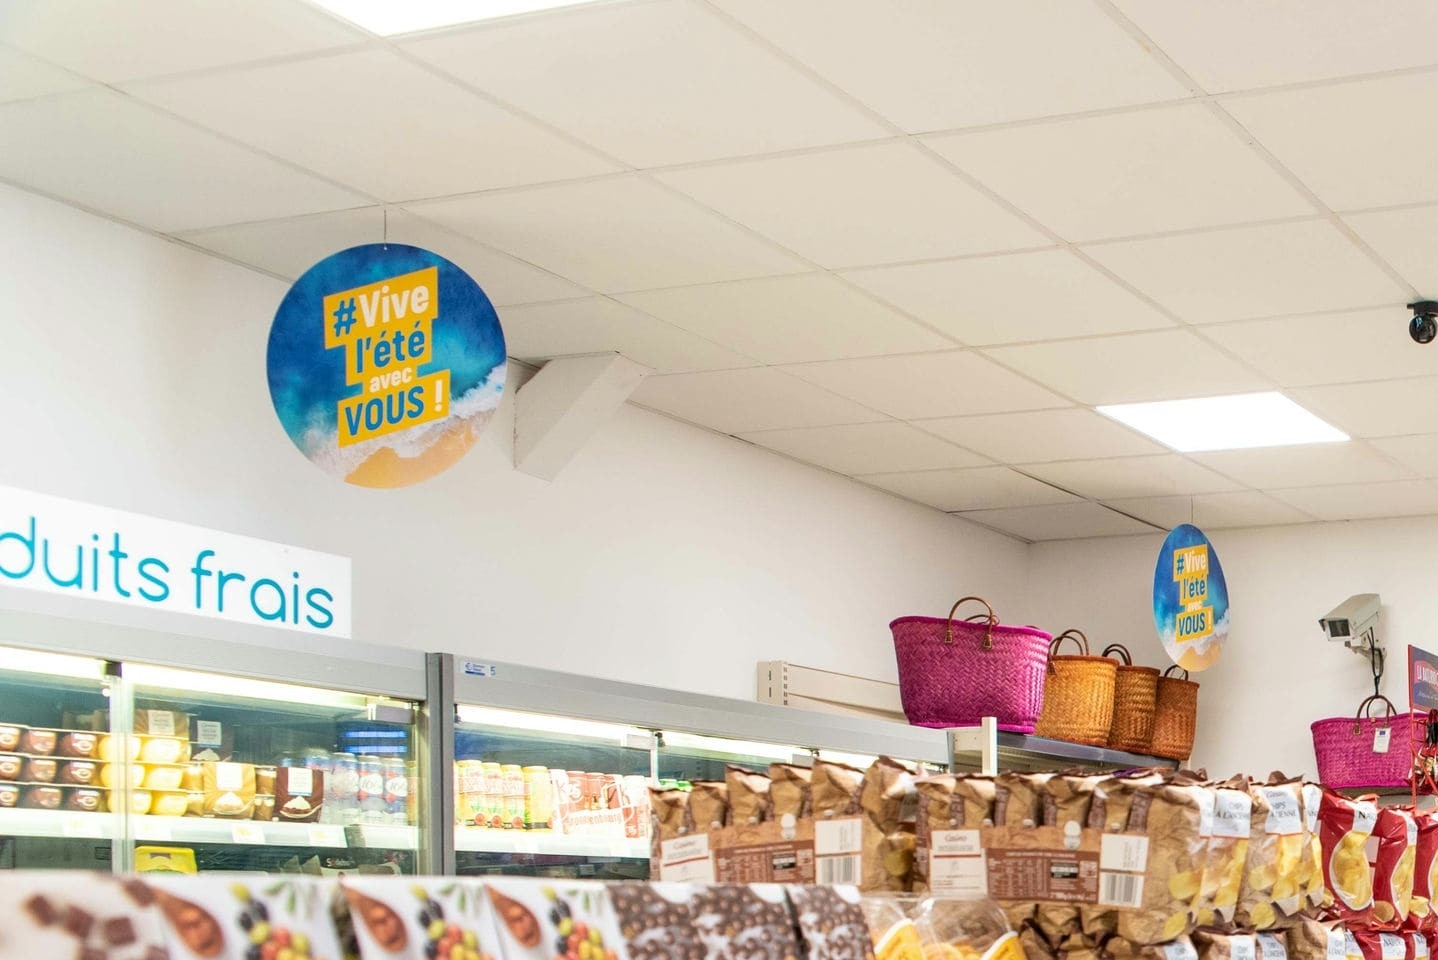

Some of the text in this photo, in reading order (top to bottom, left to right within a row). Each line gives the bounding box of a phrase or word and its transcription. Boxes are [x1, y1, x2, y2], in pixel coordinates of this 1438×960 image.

[334, 282, 429, 337] #Vive
[355, 319, 425, 371] l'été
[369, 366, 412, 392] avec
[346, 380, 443, 438] VOUS !
[1177, 552, 1206, 574] #Vive
[191, 550, 334, 629] frais
[1183, 574, 1206, 599] l'été
[1178, 613, 1205, 637] VOUS
